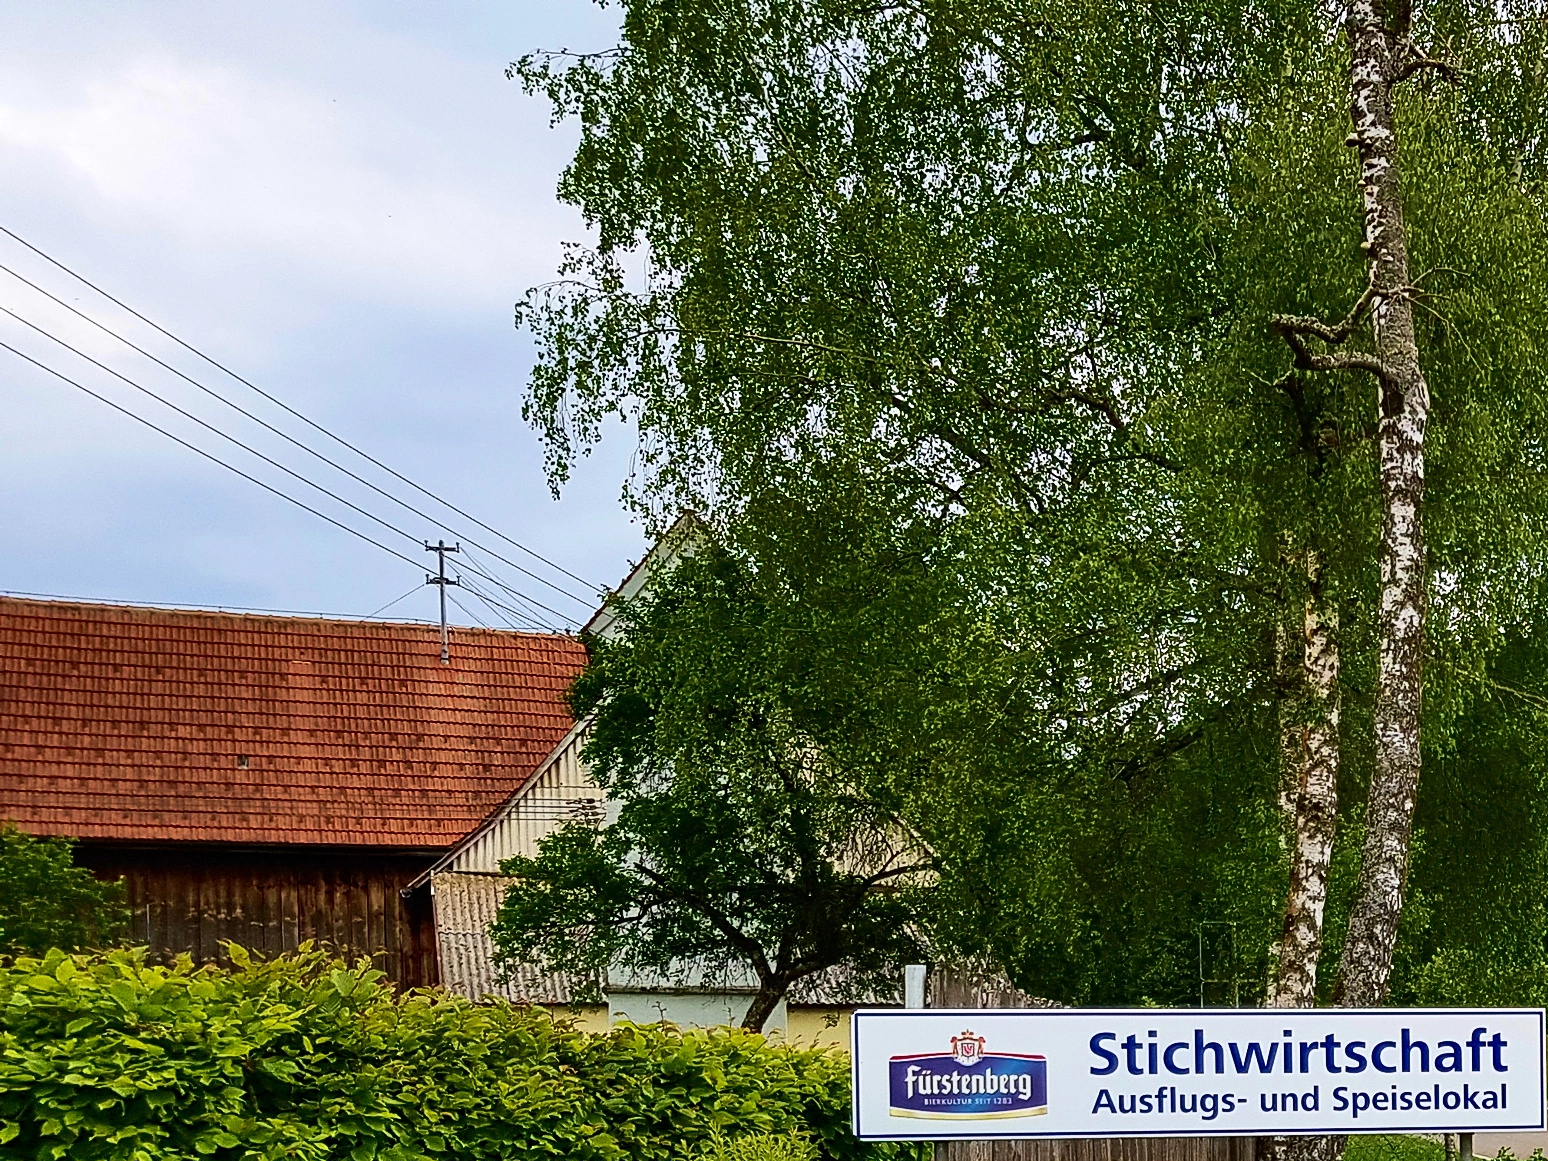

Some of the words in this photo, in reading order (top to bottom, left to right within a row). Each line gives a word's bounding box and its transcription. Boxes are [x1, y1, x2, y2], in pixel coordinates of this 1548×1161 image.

[1088, 1027, 1508, 1076] Stichwirtschaft
[904, 1064, 1032, 1101] Fürstenberg
[924, 1098, 973, 1106] BIERKULTUR
[974, 1097, 991, 1105] SEIT
[993, 1097, 1013, 1105] 1283
[1091, 1086, 1248, 1121] Ausflugs-
[1259, 1085, 1320, 1113] und
[1332, 1083, 1508, 1119] Speiselokal
